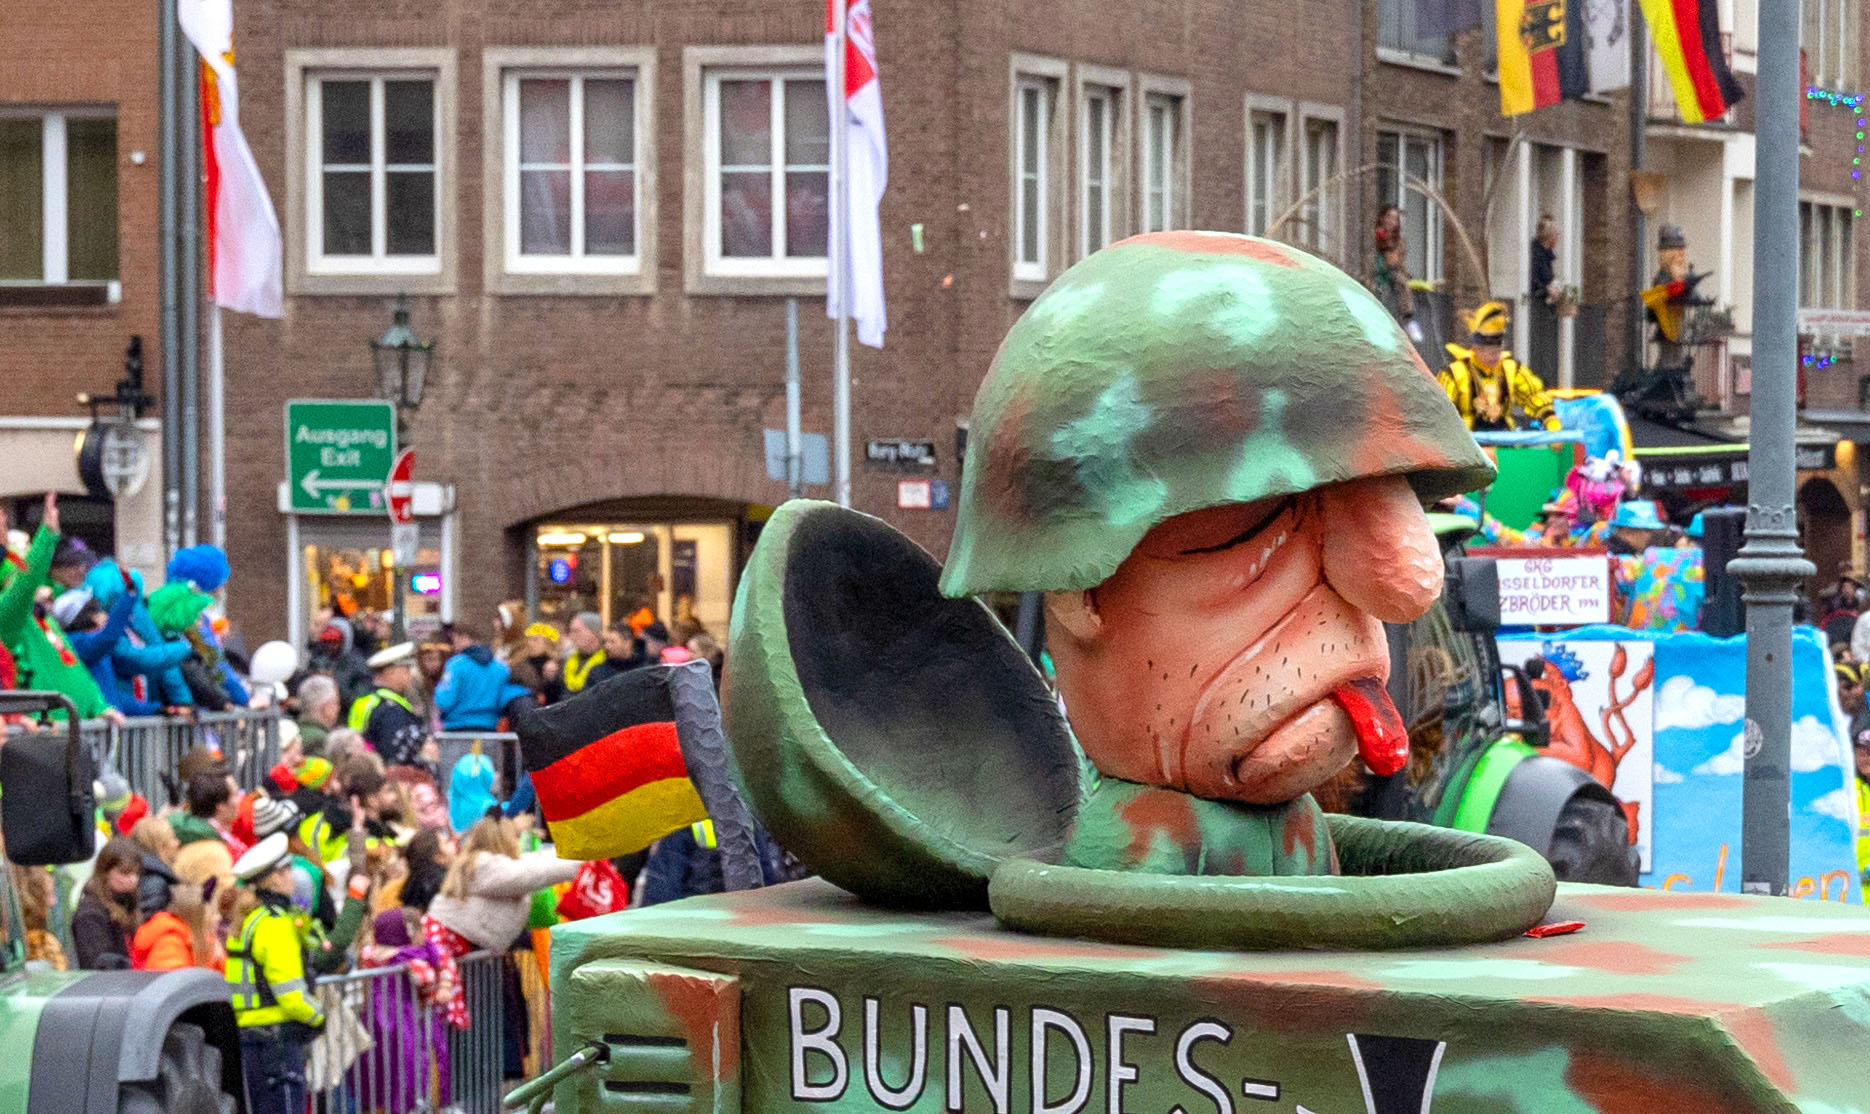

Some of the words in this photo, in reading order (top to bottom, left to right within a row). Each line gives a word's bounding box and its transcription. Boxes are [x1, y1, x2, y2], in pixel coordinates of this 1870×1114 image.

[296, 425, 388, 449] Ausgang
[320, 447, 361, 467] Exit
[1500, 575, 1602, 590] SSELDORFER
